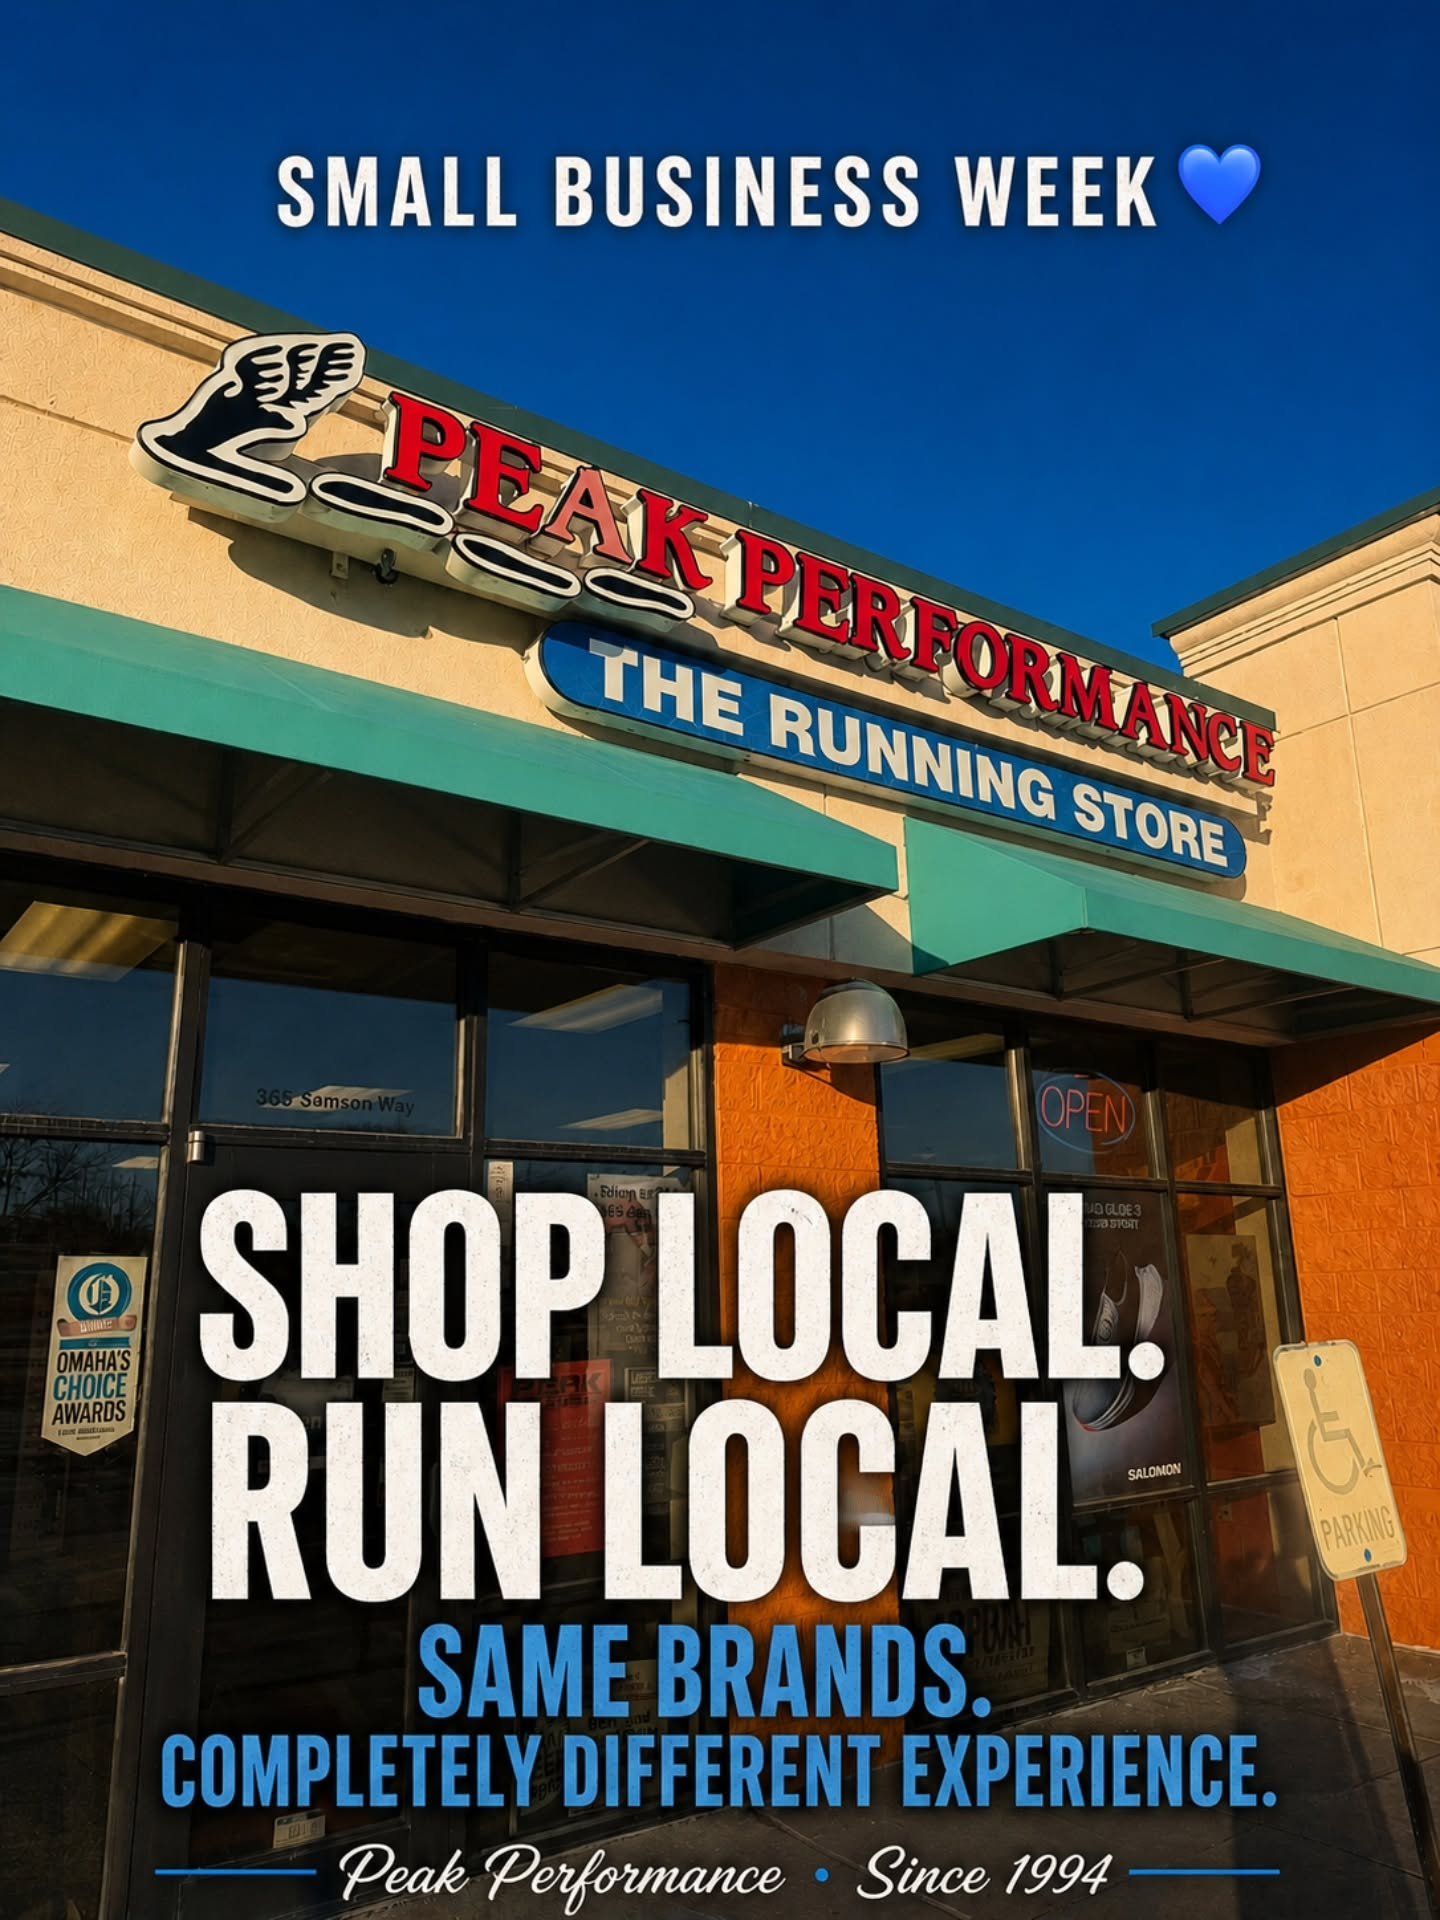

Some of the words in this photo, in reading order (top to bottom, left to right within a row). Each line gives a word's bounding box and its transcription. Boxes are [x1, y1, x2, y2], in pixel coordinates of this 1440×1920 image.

[385, 392, 713, 591] PEAK
[736, 529, 1276, 786] PERFORMANCE
[589, 638, 744, 737] THE
[768, 692, 1056, 820] RUNNING
[1073, 783, 1228, 868] STORE
[255, 1088, 293, 1108] 365
[377, 1095, 415, 1117] Way
[1041, 1085, 1126, 1134] OPEN
[56, 1349, 131, 1374] OMAHA'S
[53, 1373, 128, 1401] CHOICE
[52, 1400, 126, 1426] AWARDS
[1127, 1462, 1182, 1481] SALOMON
[1320, 1505, 1396, 1551] PARKING
